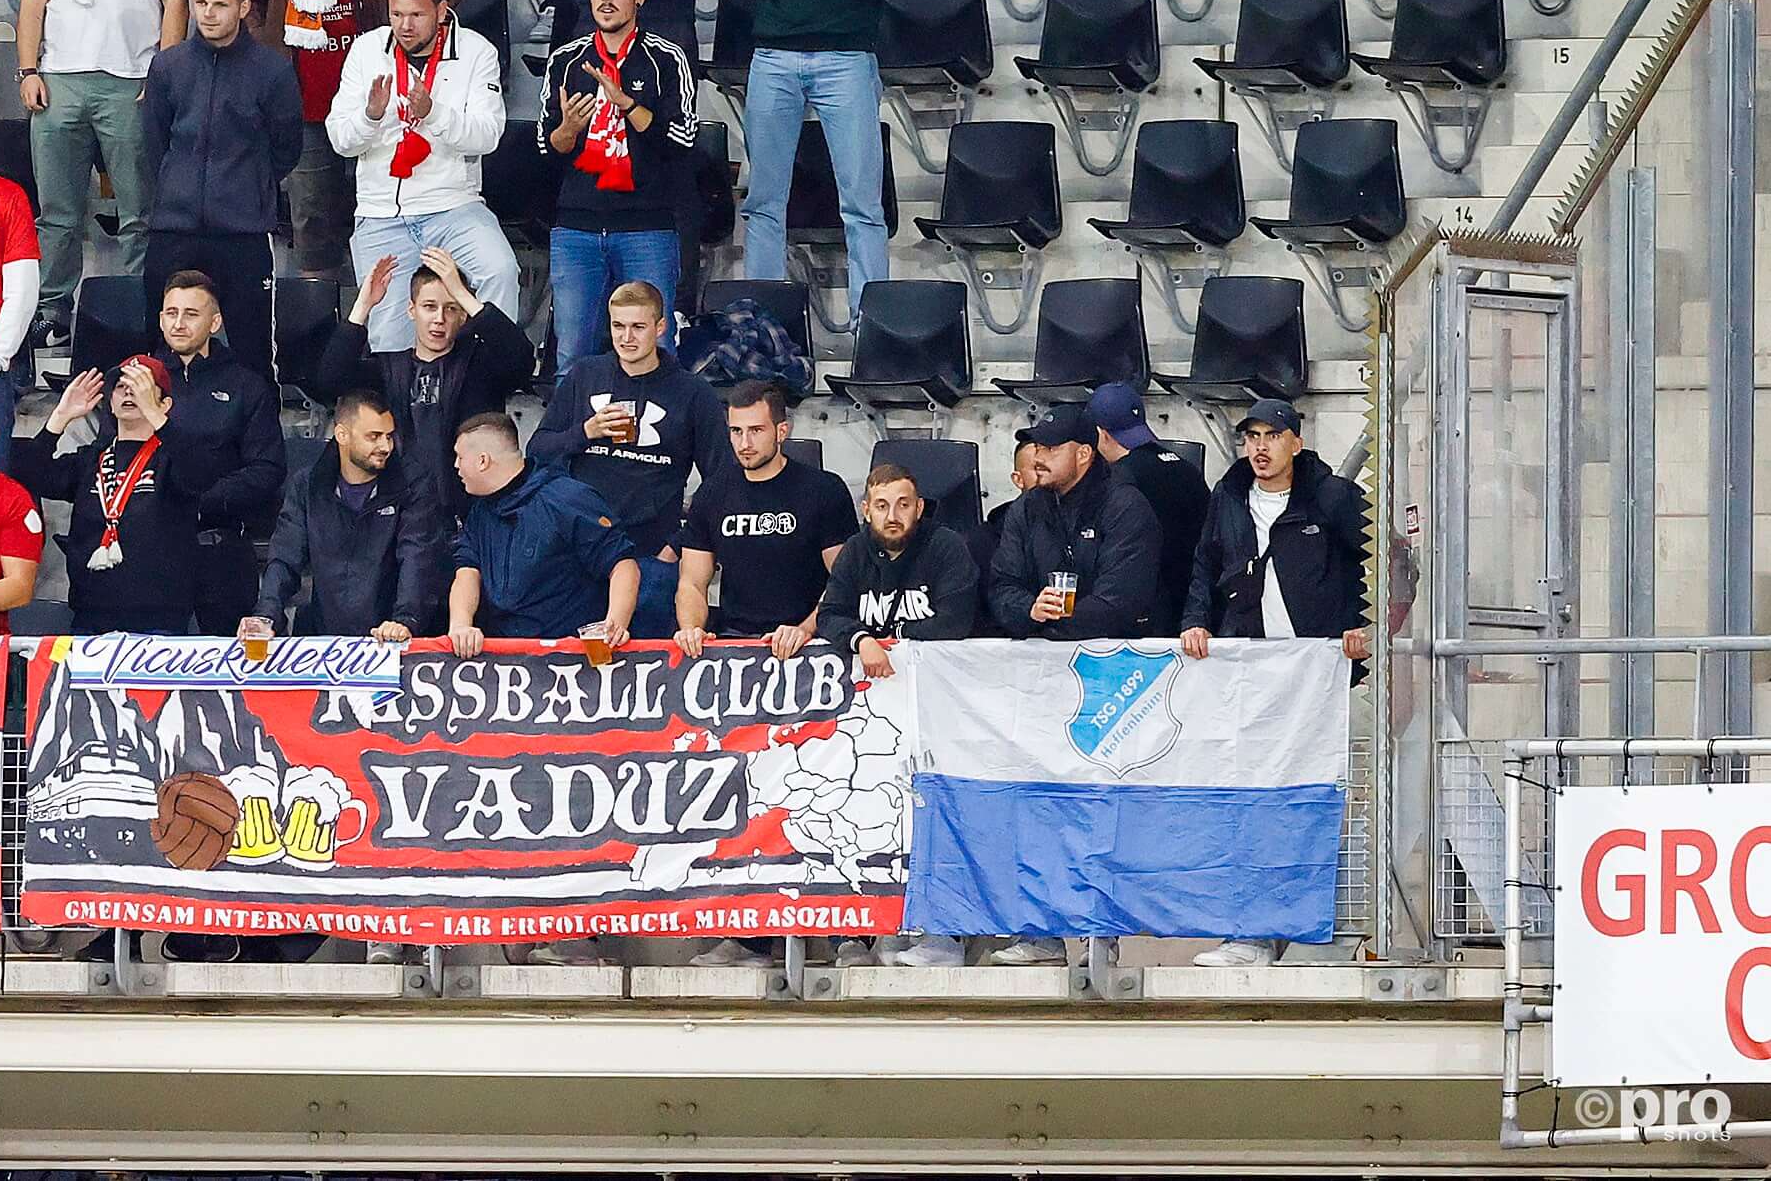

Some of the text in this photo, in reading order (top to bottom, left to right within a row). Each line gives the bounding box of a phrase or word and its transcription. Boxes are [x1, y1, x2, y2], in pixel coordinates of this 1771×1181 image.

[1552, 47, 1570, 65] 15
[1454, 207, 1474, 224] 14
[611, 449, 672, 466] ARMOUR
[681, 655, 846, 726] CLUB
[1090, 669, 1146, 731] TSG 1899
[1100, 690, 1165, 758] Hoffenheim
[378, 757, 739, 840] VADUZ
[64, 900, 196, 926] GMEINSAM
[203, 908, 414, 936] INTERNATIONAL
[765, 906, 875, 929] ASOZIAL
